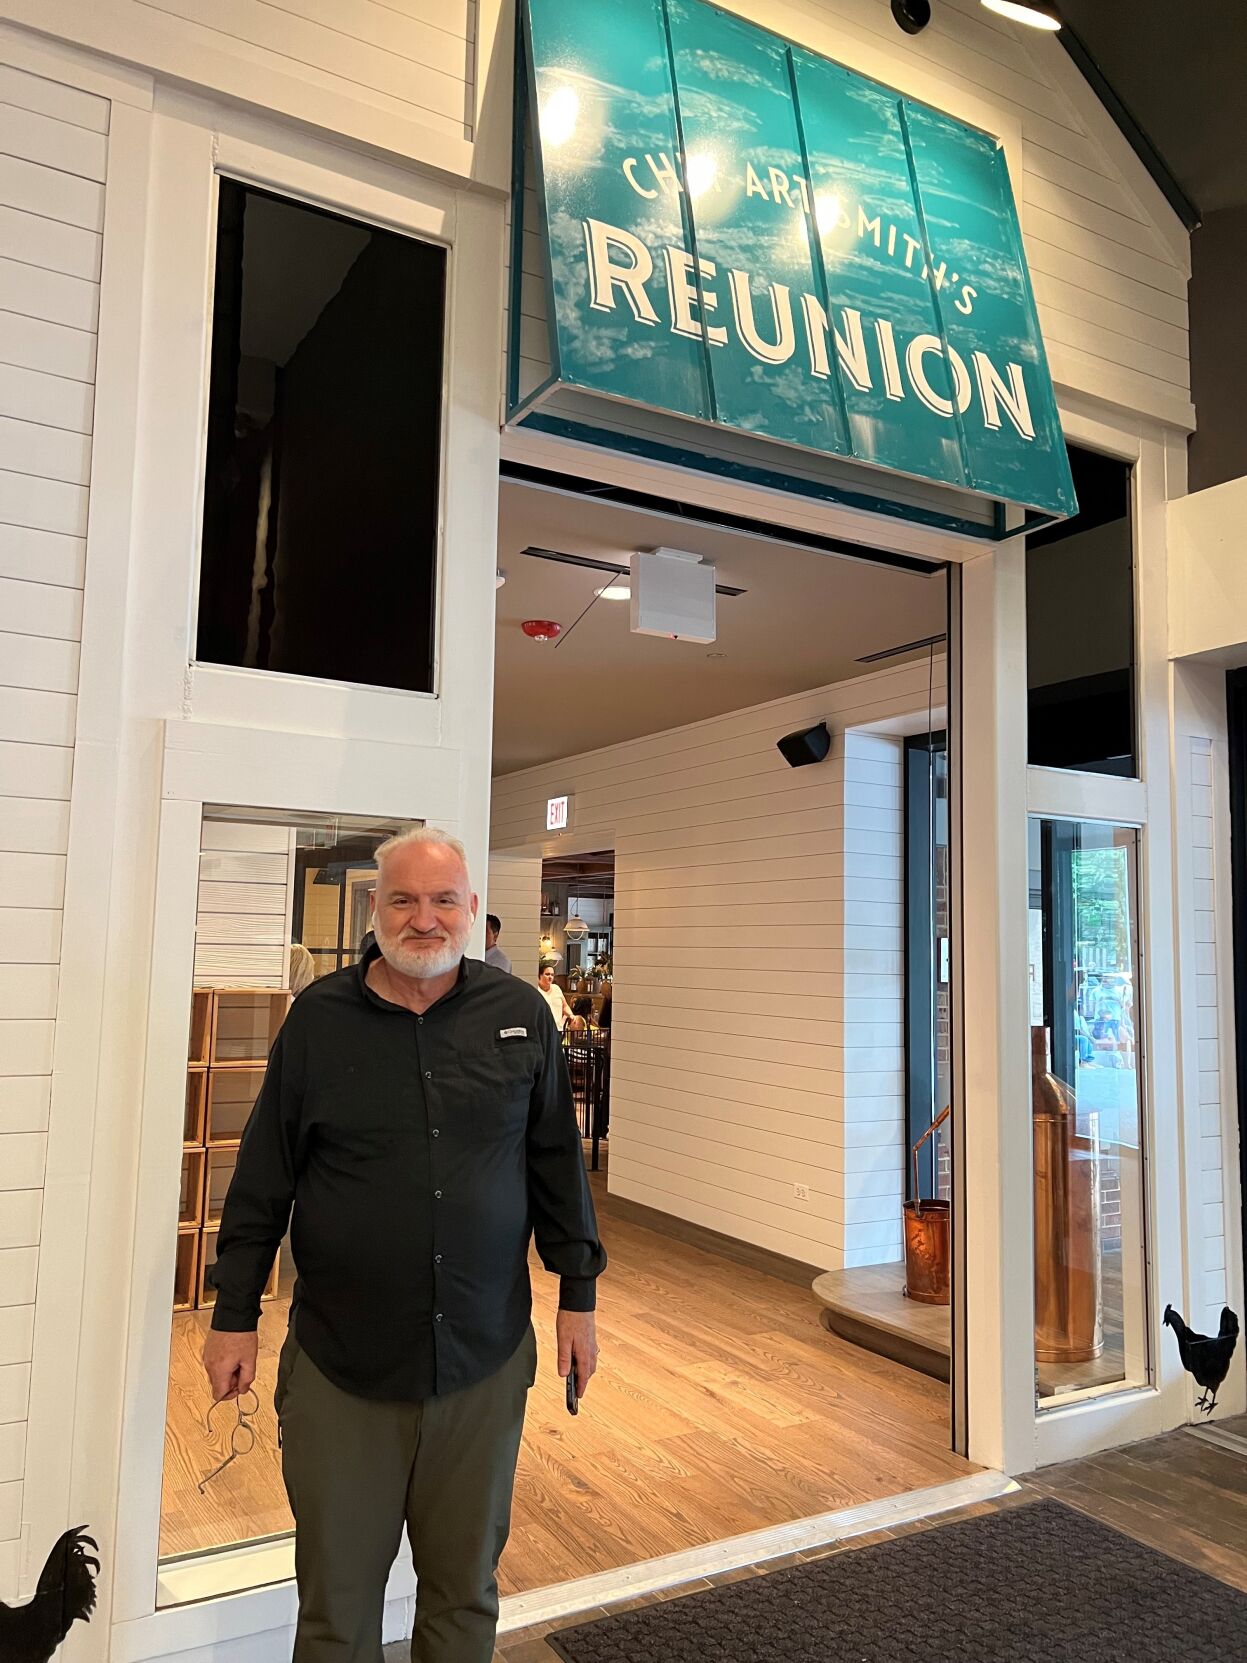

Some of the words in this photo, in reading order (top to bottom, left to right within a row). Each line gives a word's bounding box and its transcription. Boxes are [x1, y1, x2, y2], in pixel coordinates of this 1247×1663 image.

[622, 152, 722, 199] CH
[746, 162, 812, 214] ART
[582, 217, 1036, 441] REUNION
[550, 801, 565, 825] EXIT
